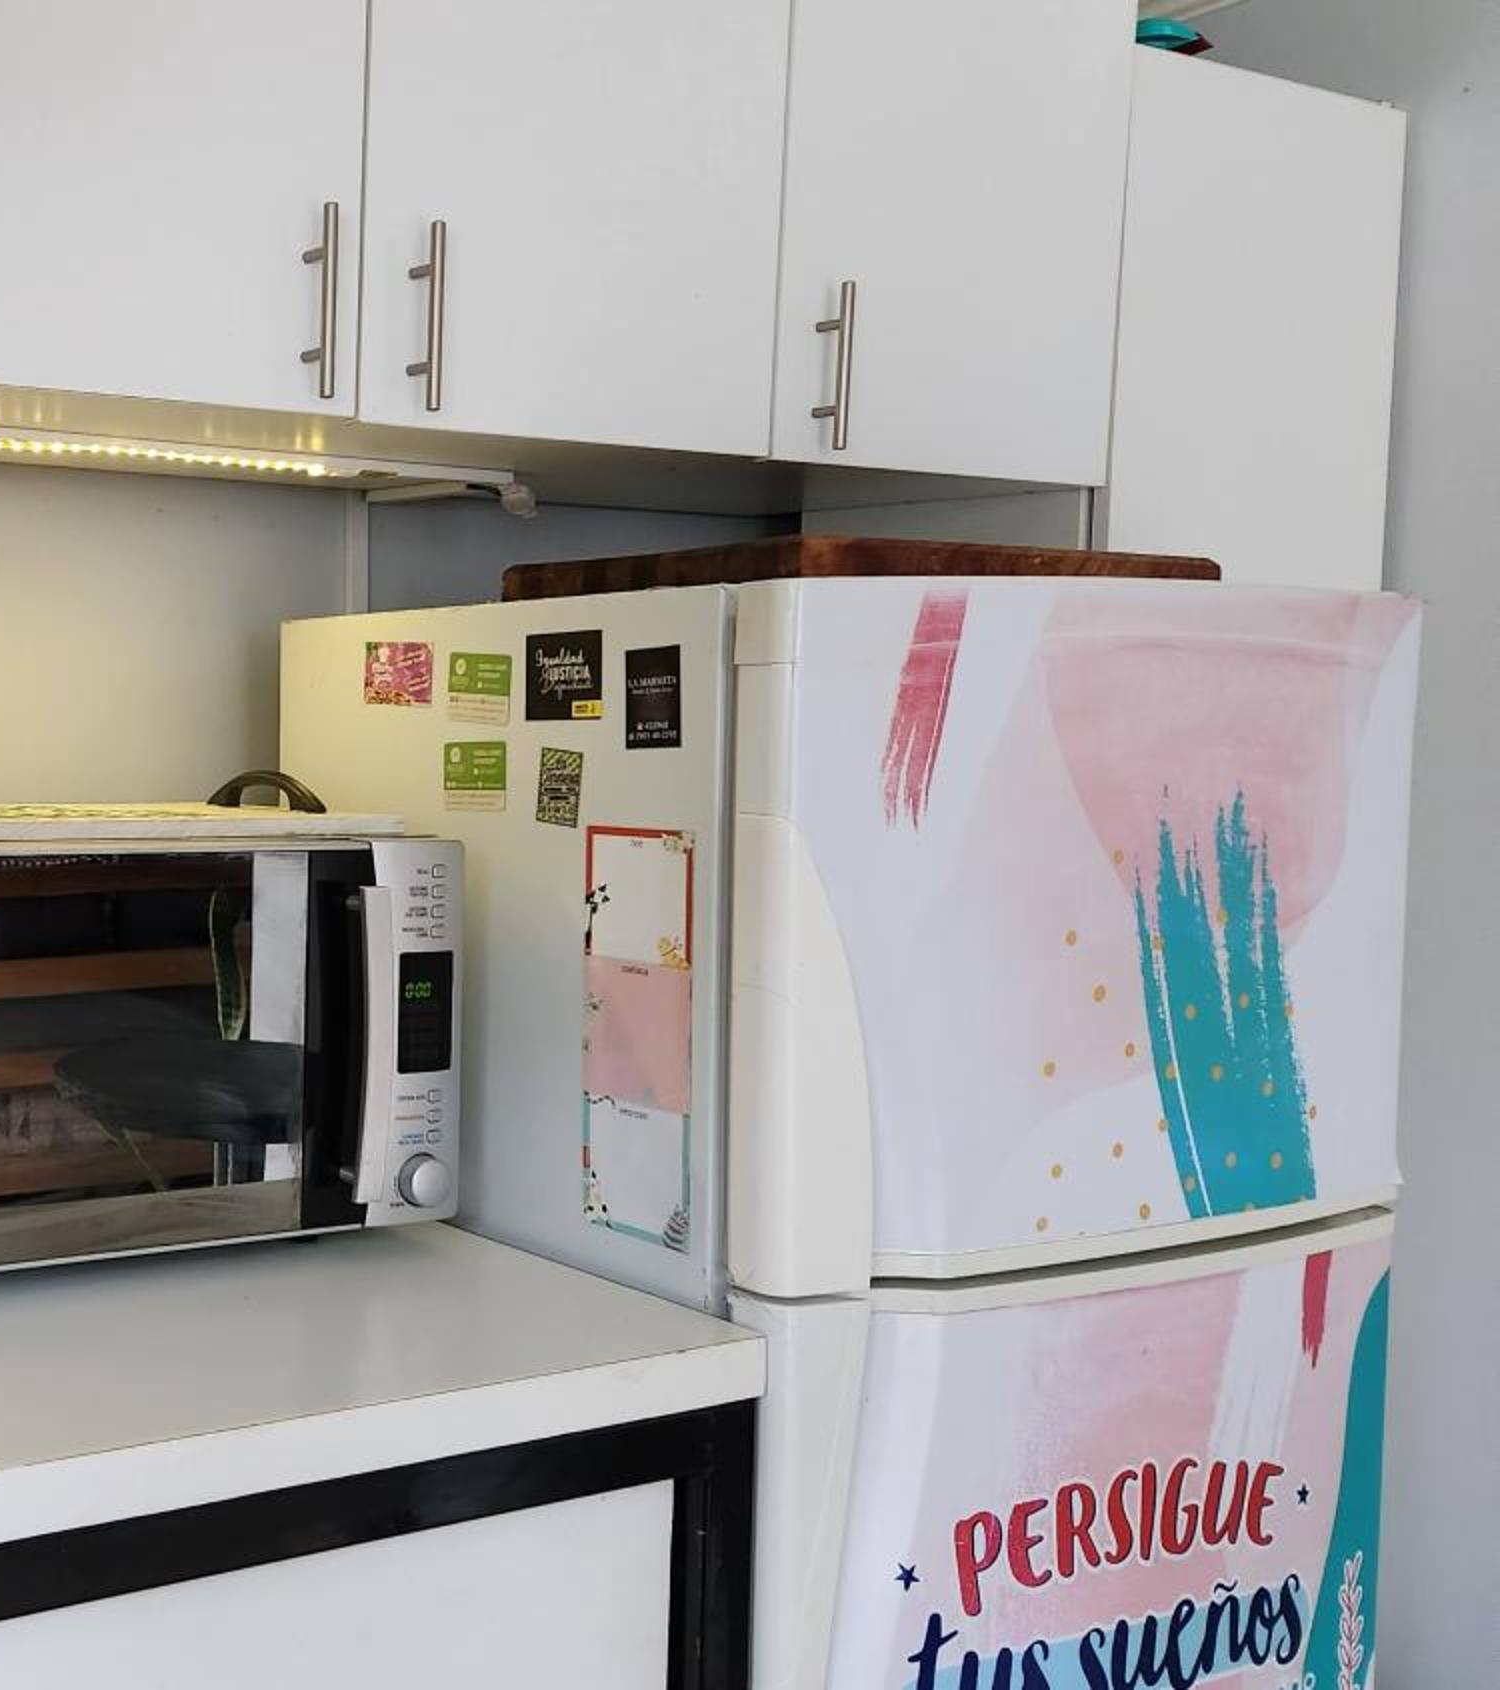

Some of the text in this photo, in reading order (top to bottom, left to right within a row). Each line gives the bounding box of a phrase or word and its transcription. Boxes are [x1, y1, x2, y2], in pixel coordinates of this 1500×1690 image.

[953, 1457, 1285, 1616] PERSIGUE
[908, 1573, 1301, 1690] tus sueños
